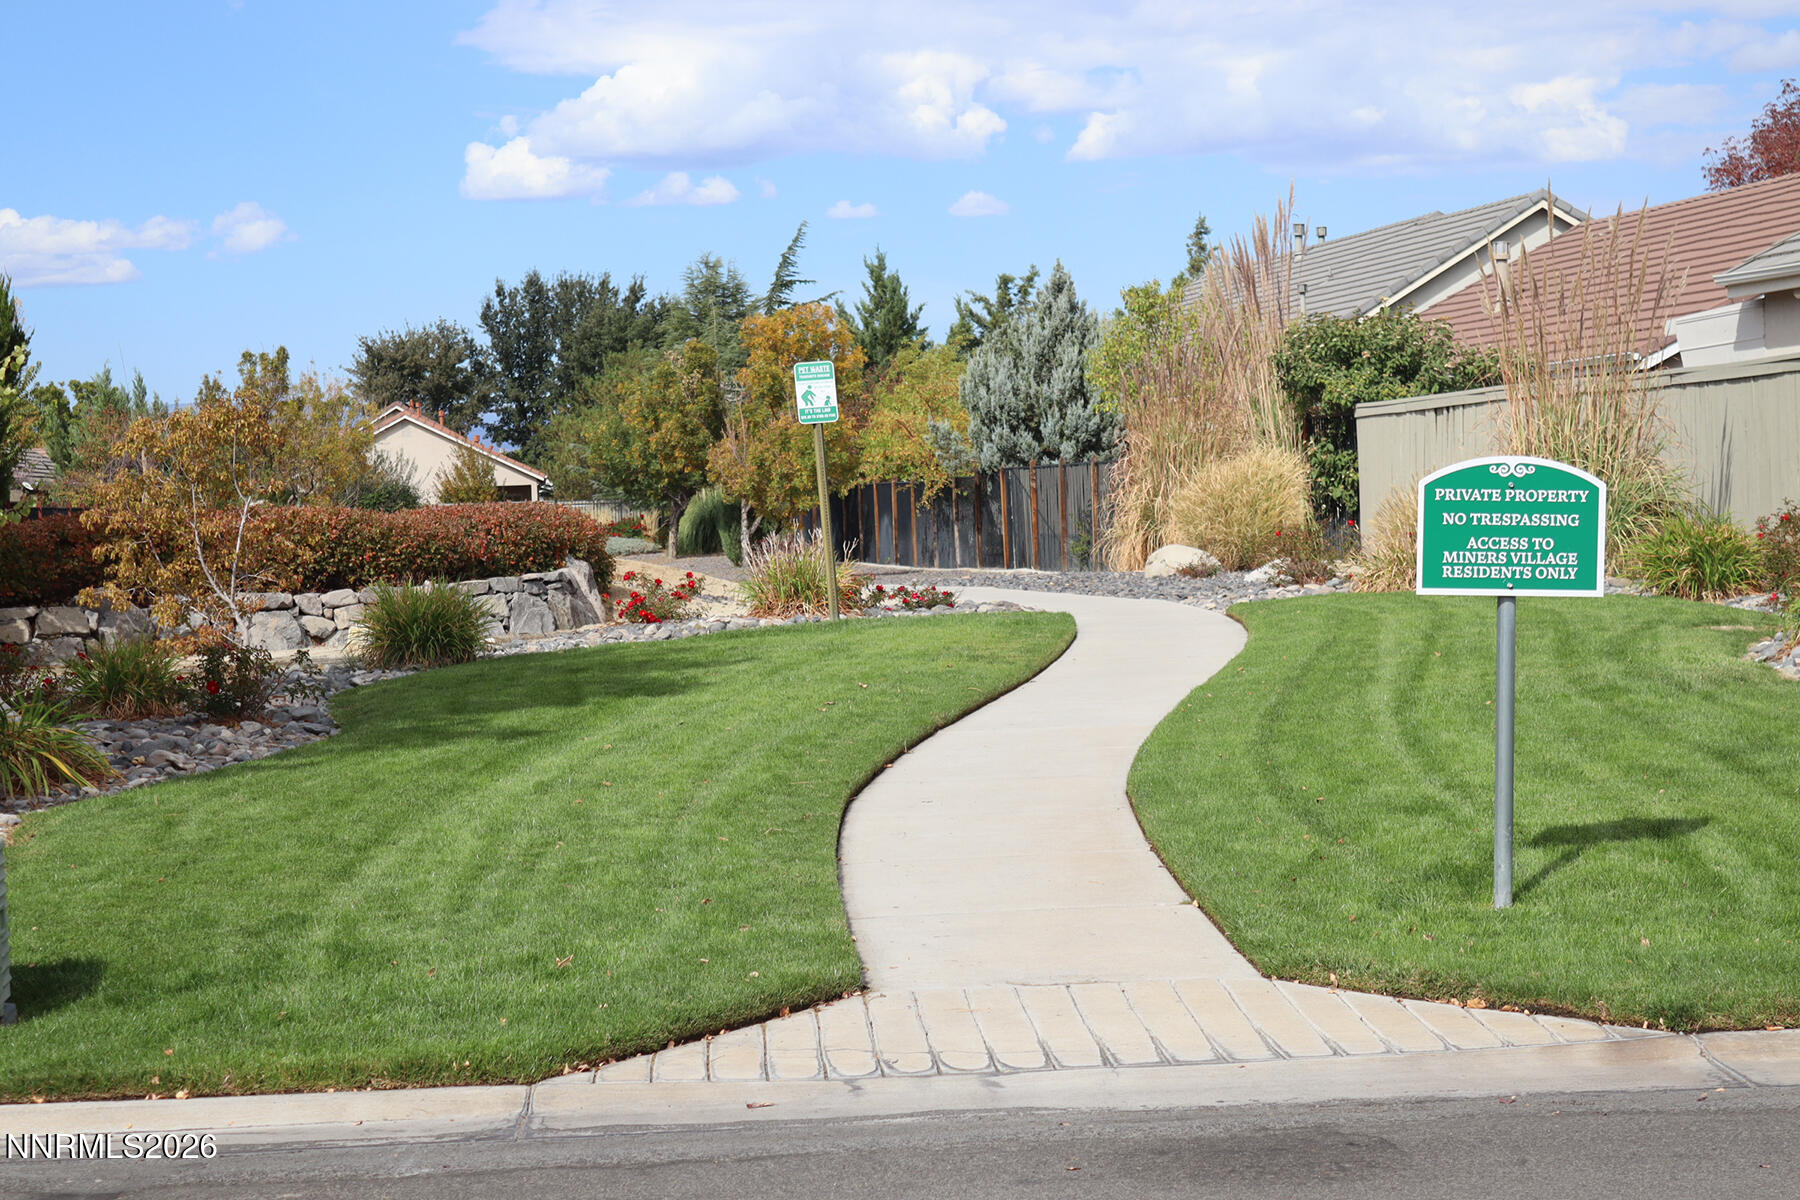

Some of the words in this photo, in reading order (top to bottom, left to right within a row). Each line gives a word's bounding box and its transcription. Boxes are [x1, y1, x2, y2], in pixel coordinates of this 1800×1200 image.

[810, 365, 831, 373] WASTE
[1434, 488, 1501, 502] PRIVATE
[1505, 489, 1589, 503] PROPERTY
[1442, 512, 1466, 526] NO
[1469, 513, 1580, 527] TRESPASSING
[1466, 537, 1528, 550] ACCESS
[1532, 537, 1554, 551] TO
[1442, 551, 1507, 564] MINERS
[1510, 552, 1578, 565] VILLAGE
[1442, 565, 1532, 579] RESIDENTS
[1535, 566, 1579, 580] ONLY
